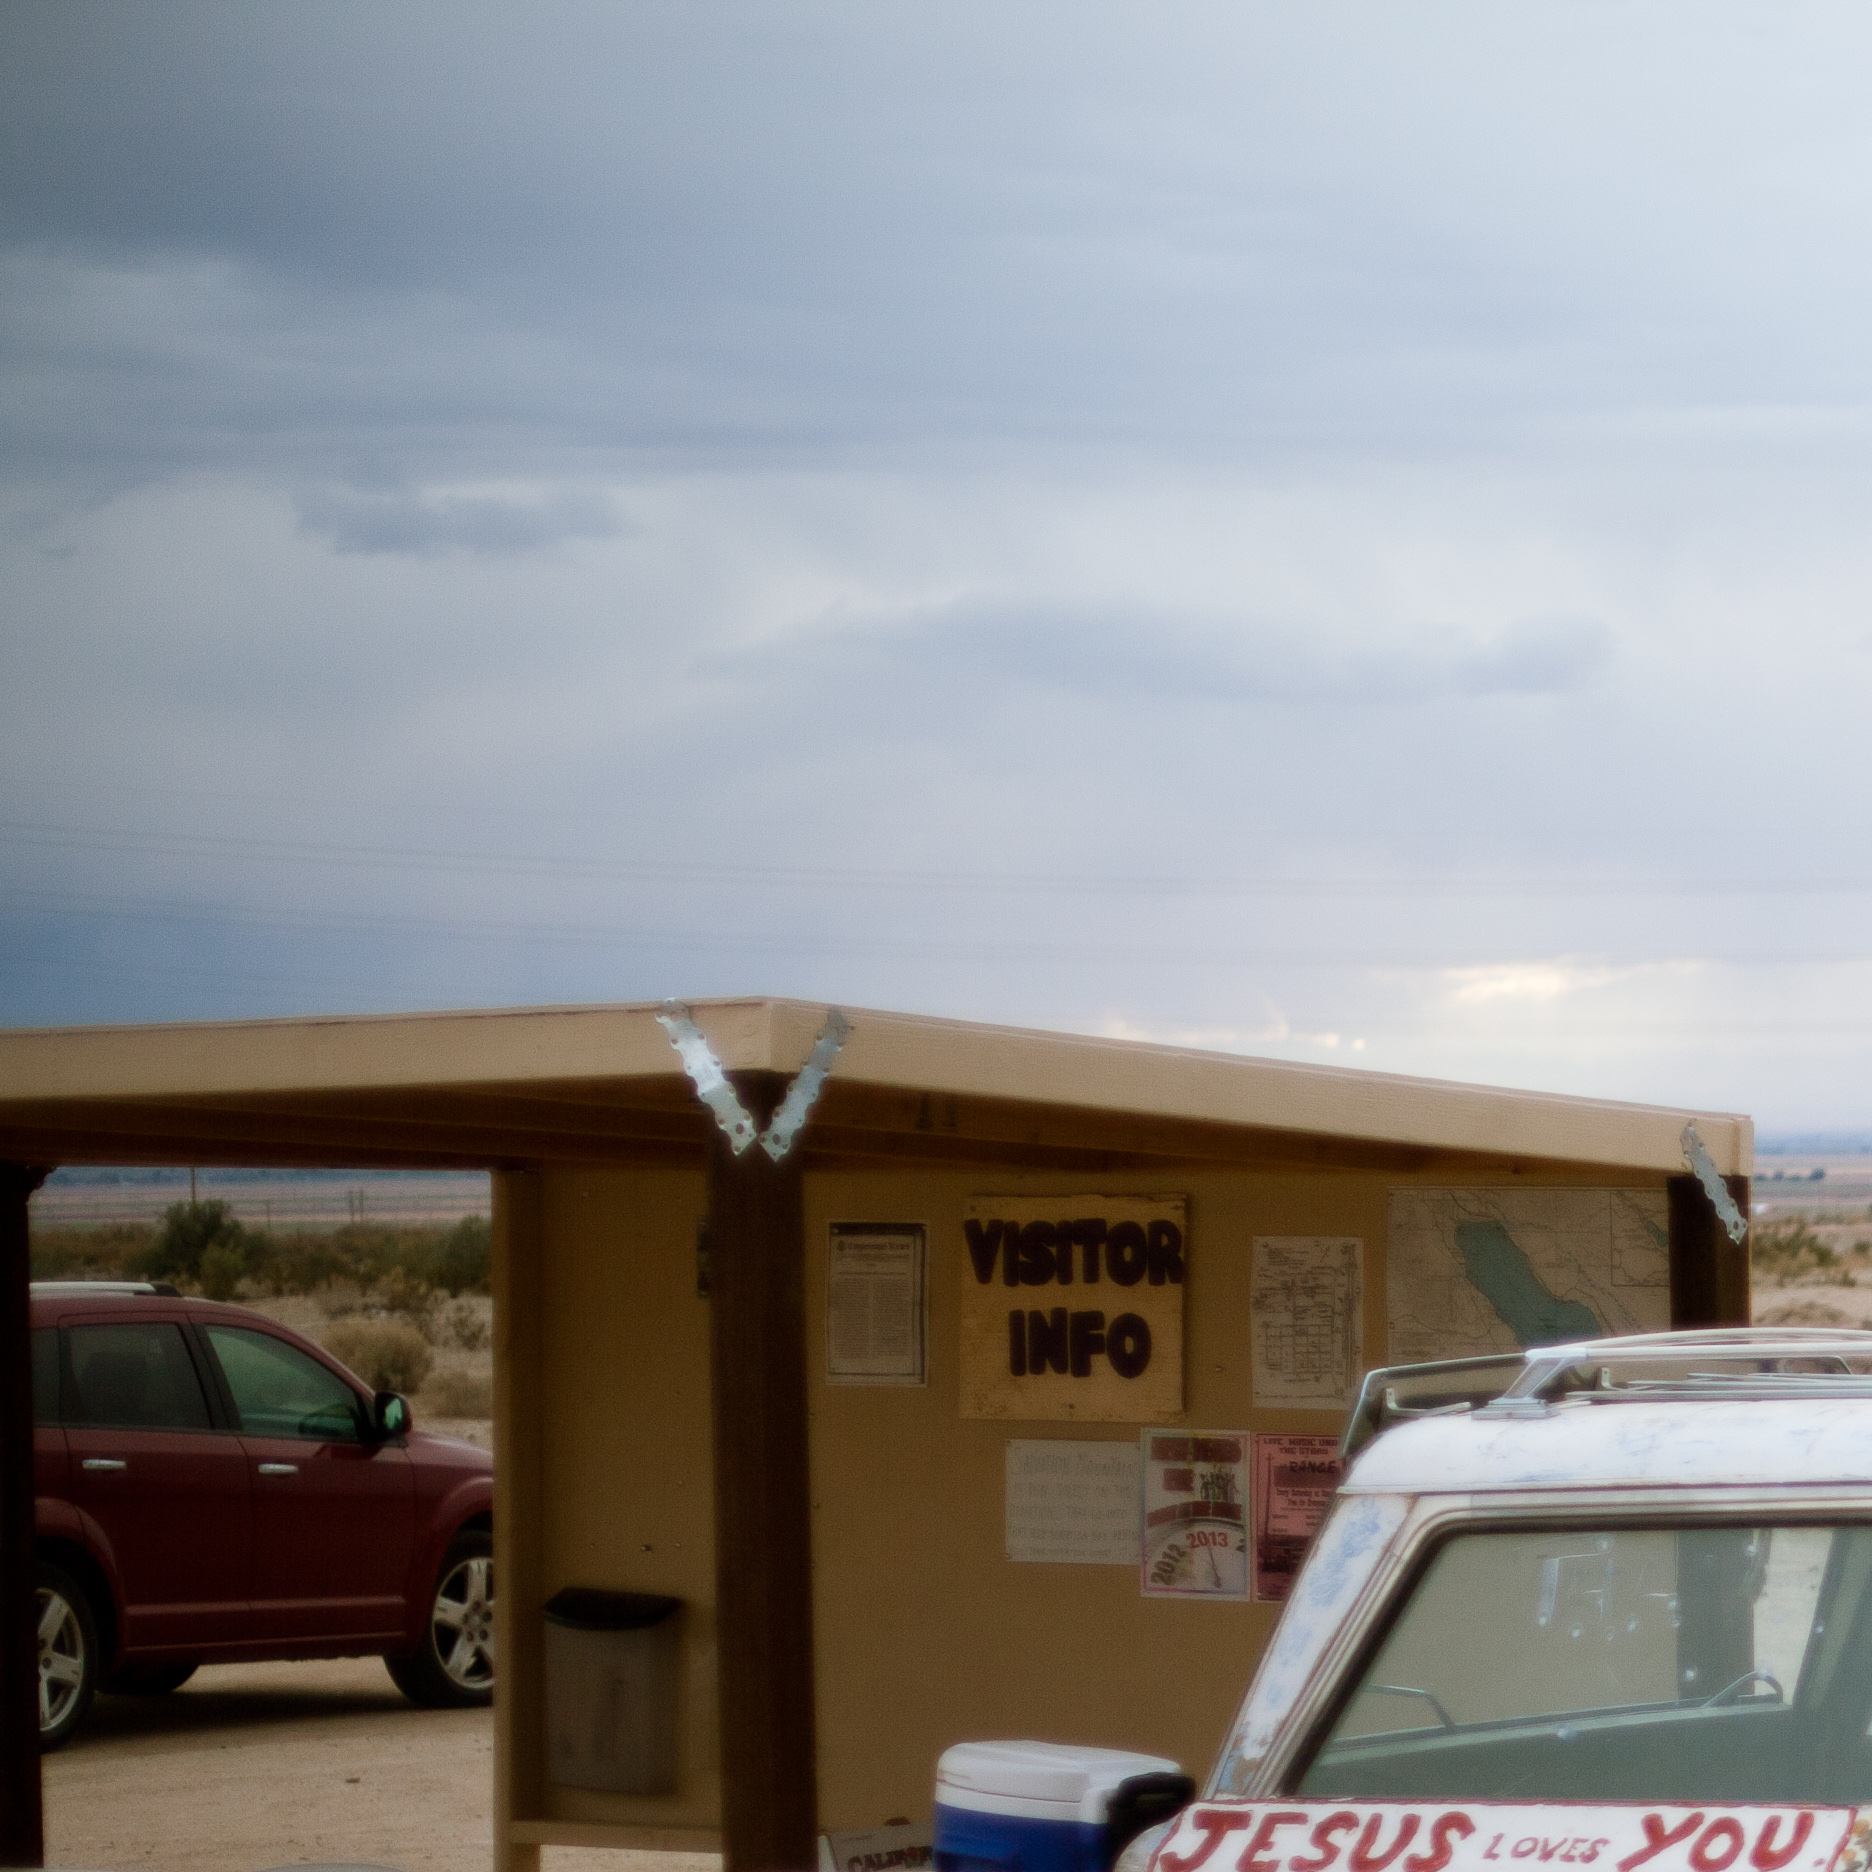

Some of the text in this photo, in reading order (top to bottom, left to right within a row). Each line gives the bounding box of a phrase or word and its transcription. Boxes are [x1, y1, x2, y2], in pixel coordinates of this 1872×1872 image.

[963, 1218, 1184, 1287] VISITOR
[1008, 1306, 1152, 1379] INFO
[1289, 1460, 1337, 1474] RANGE
[1186, 1531, 1229, 1549] 2013
[1151, 1543, 1187, 1585] 2012
[1482, 1833, 1611, 1864] LOVES
